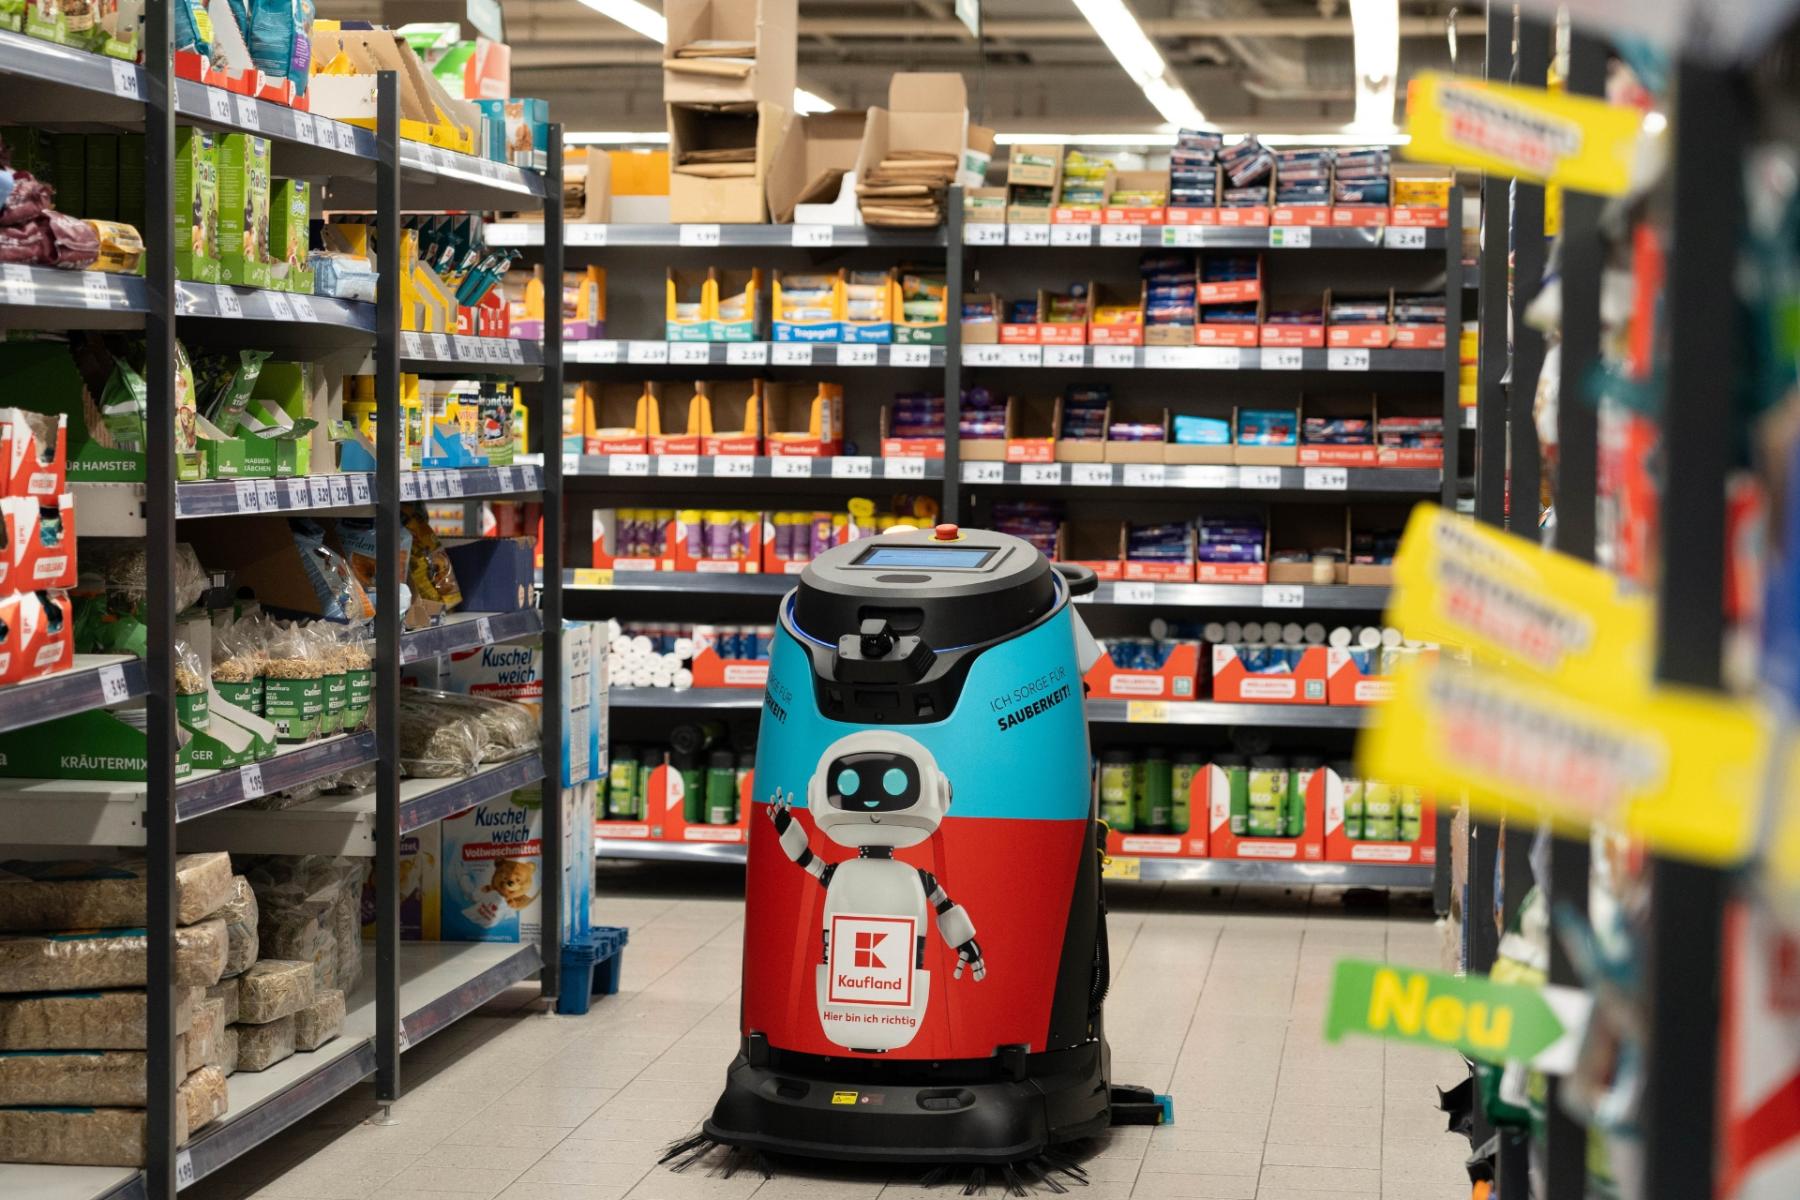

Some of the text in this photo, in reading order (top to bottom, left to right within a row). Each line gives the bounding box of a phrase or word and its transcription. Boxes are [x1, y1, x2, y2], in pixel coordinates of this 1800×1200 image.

[217, 101, 230, 122] 1.29
[980, 231, 1003, 241] 2.99
[1025, 231, 1047, 241] 2.99
[1066, 231, 1089, 241] 2.49
[1115, 232, 1138, 242] 2.49
[1400, 234, 1425, 244] 2.49
[1058, 353, 1081, 363] 2.49
[1343, 356, 1367, 366] 2.79
[82, 461, 136, 471] HAMSTER
[673, 461, 696, 472] 2.99
[729, 462, 752, 472] 2.95
[902, 465, 922, 474] 1.99
[978, 468, 1001, 478] 2.49
[1035, 470, 1058, 480] 2.49
[243, 492, 257, 508] 0.95
[265, 492, 278, 507] 0.95
[318, 489, 331, 503] 3.29
[337, 488, 349, 502] 2.29
[358, 487, 370, 500] 2.29
[482, 647, 533, 668] Kuschel
[498, 666, 536, 684] weich
[110, 678, 128, 697] 3.95
[472, 685, 543, 698] Vollwaschmitte
[990, 665, 1067, 712] ICH SORGE FÜR
[997, 683, 1071, 732] SAUBERKEIT!
[191, 750, 213, 760] GER
[60, 754, 148, 771] KRÄUTERMIX
[249, 775, 263, 792] 1.95
[475, 807, 527, 828] Kuschel
[492, 825, 530, 843] weich
[464, 844, 541, 858] Vollwaschmittel
[838, 975, 902, 990] Kaufland
[1368, 968, 1514, 1049] Neu
[824, 1012, 916, 1028] Hier bin ich richtig
